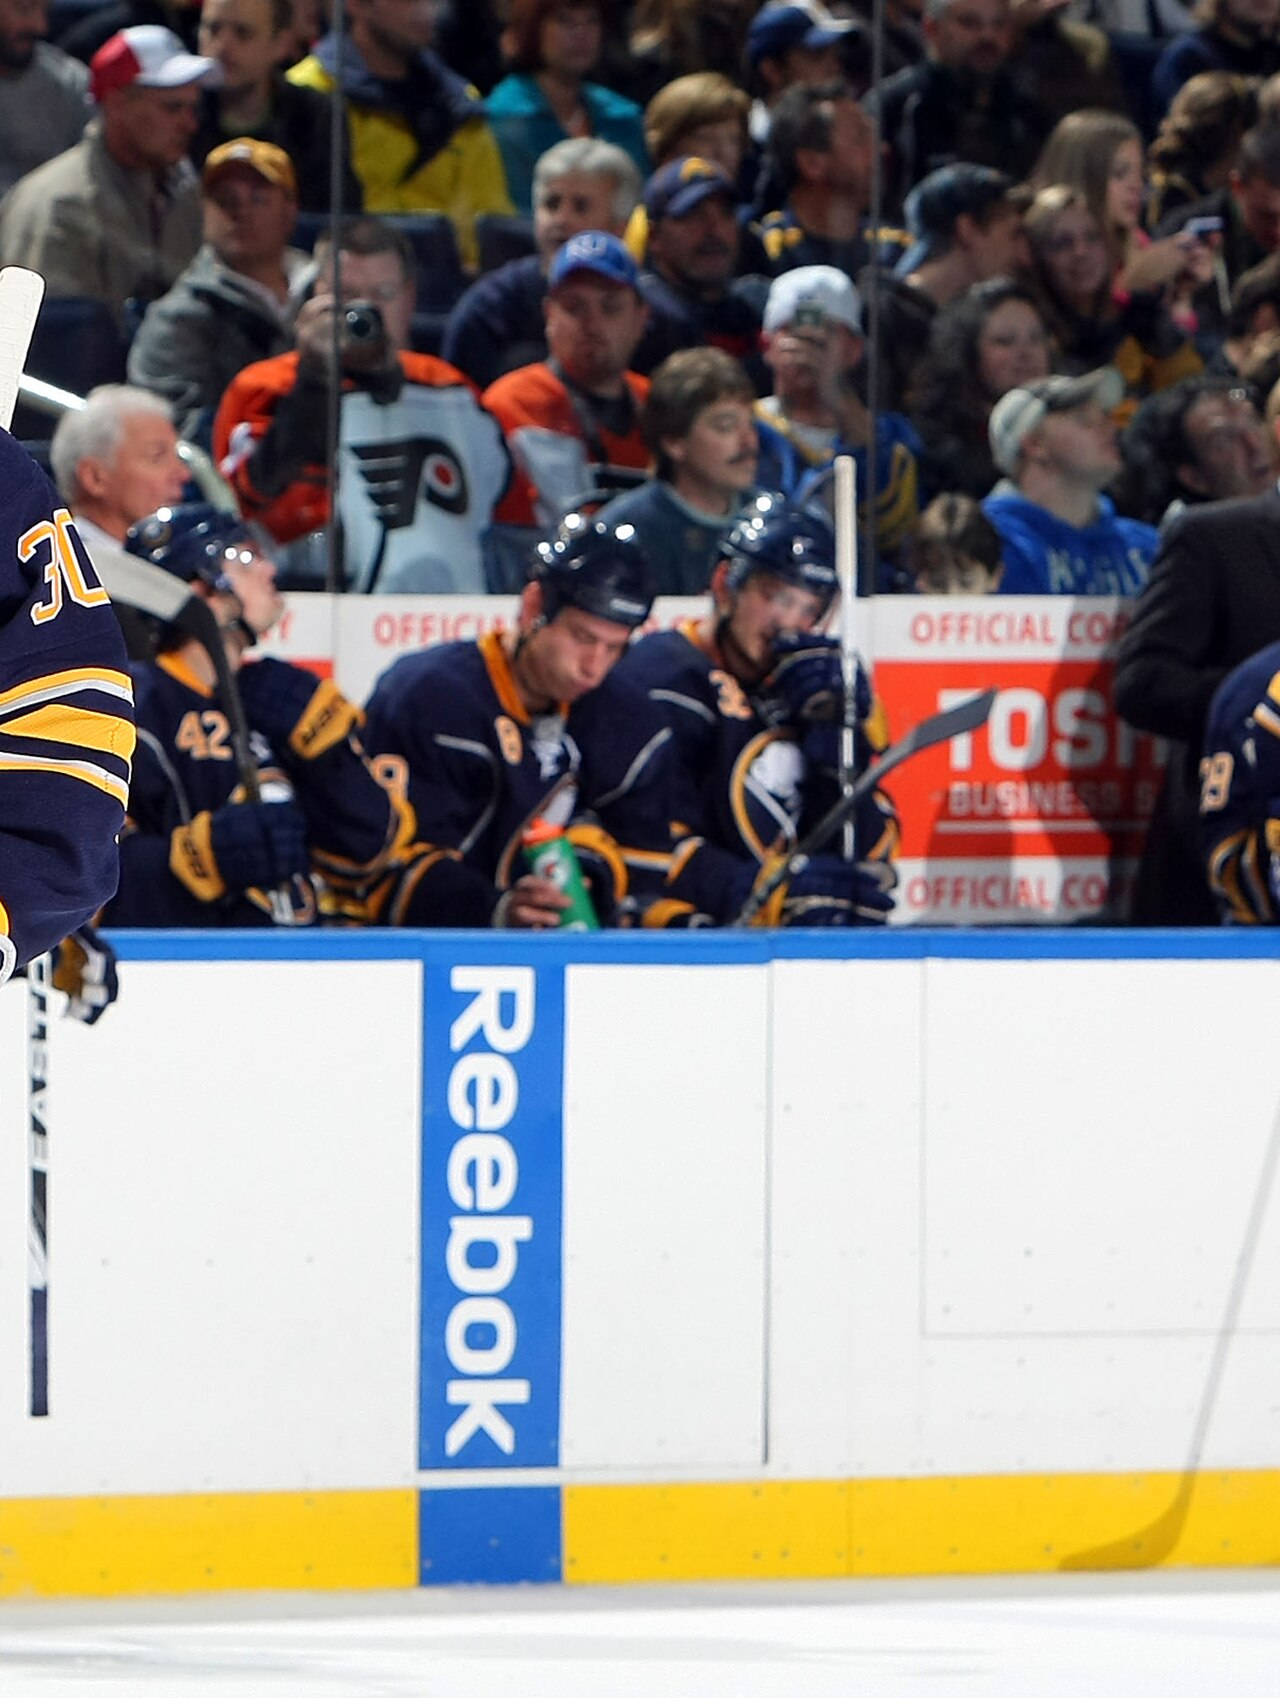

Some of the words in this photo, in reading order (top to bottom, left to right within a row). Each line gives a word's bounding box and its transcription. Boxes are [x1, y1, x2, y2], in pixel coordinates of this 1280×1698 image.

[909, 609, 1055, 646] OFFICIAL
[175, 710, 234, 761] 42
[946, 780, 1123, 817] BUSINESS
[906, 874, 1053, 910] OFFICIAL
[444, 965, 536, 1458] Reebok
